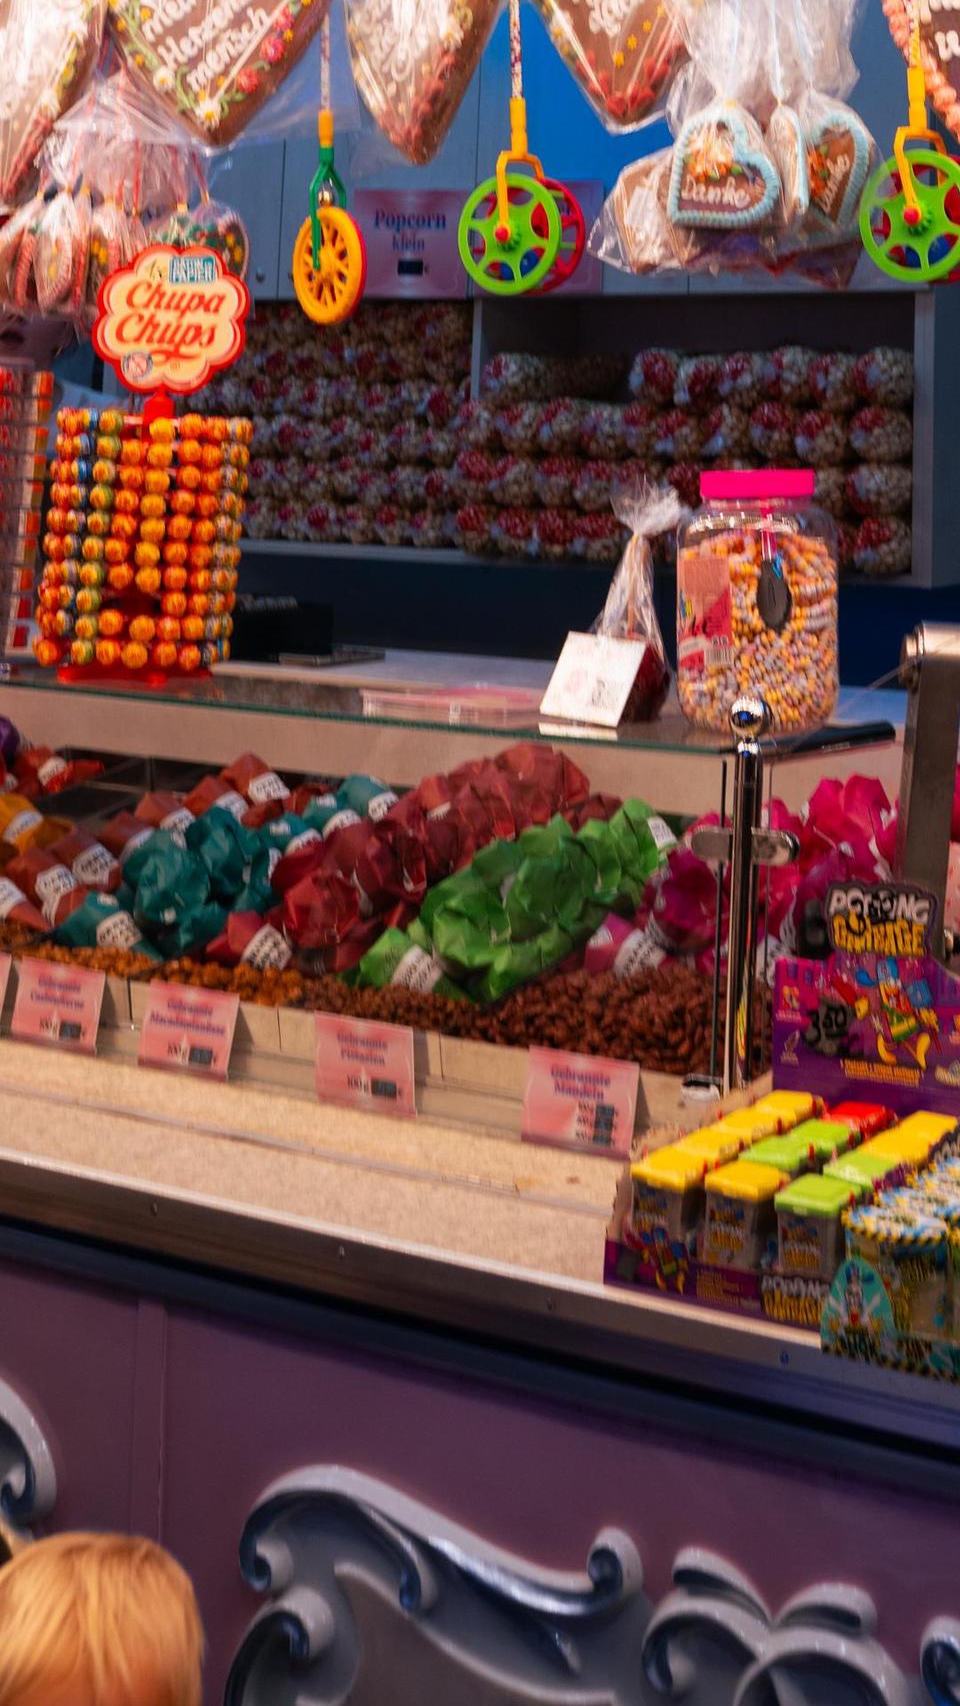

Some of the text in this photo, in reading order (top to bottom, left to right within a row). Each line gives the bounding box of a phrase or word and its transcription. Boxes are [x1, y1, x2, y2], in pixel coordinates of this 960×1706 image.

[374, 208, 446, 233] Popcorn
[126, 280, 226, 319] Chupa
[115, 312, 217, 356] Chups
